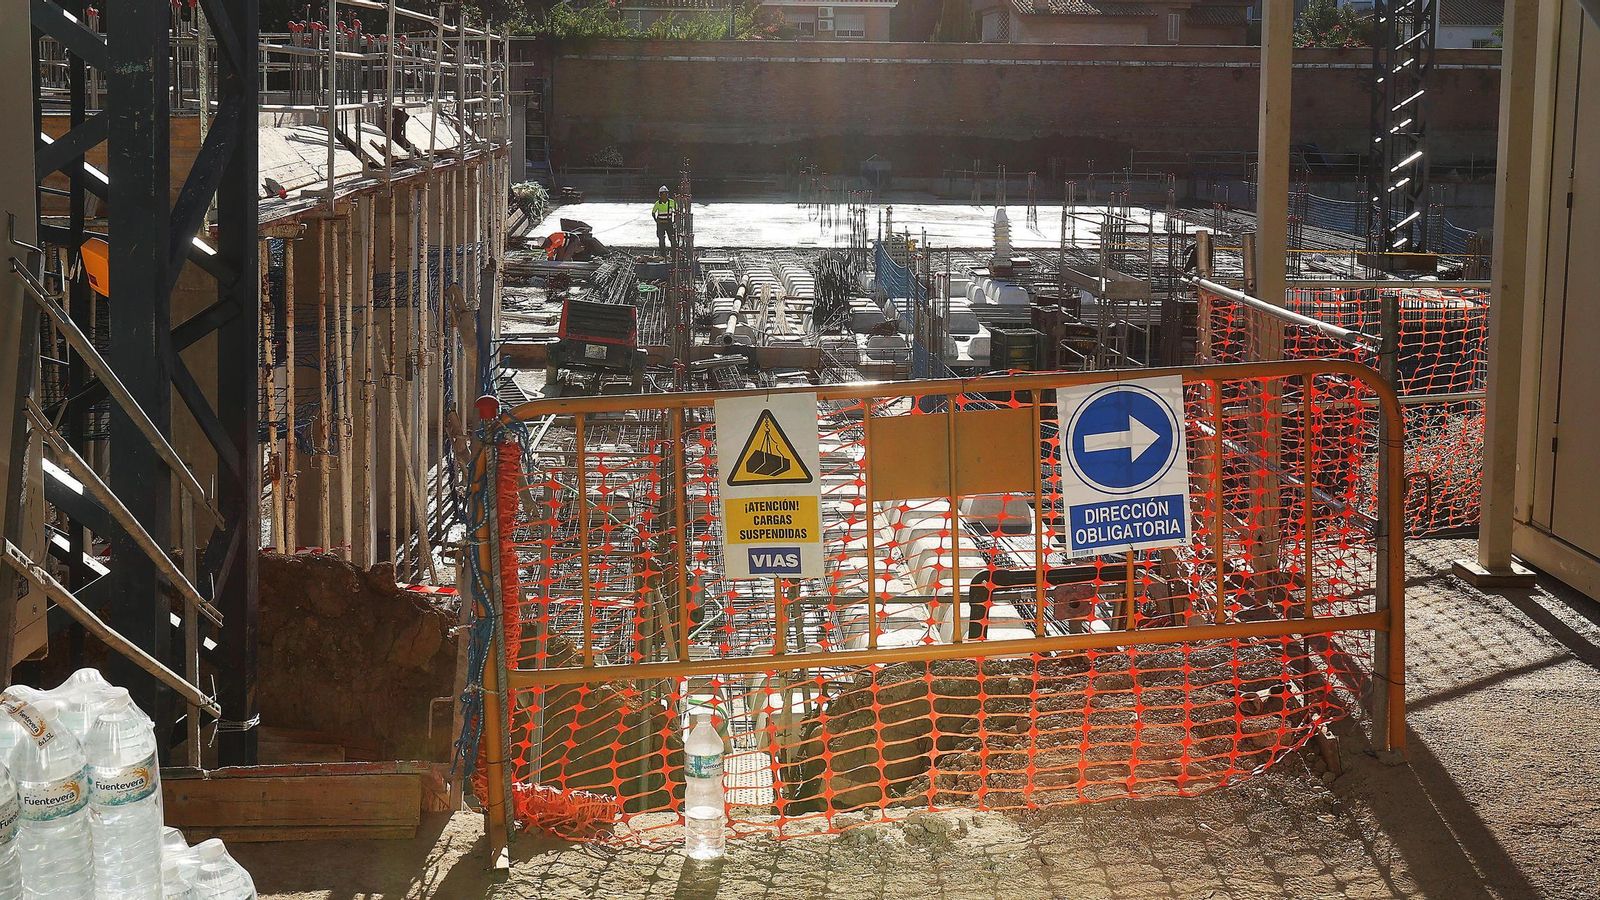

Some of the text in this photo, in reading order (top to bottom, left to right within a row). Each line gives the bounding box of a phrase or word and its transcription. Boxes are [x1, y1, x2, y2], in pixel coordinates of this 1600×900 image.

[744, 498, 799, 514] ¡ATENCIÓN!
[1085, 497, 1169, 525] DIRECCIÓN
[753, 514, 792, 526] CARGAS
[739, 528, 807, 540] SUSPENDIDAS
[1075, 518, 1181, 545] OBLIGATORIA
[751, 553, 799, 568] VIAS
[95, 778, 144, 790] Fuentevera
[24, 791, 75, 805] Fuentevera
